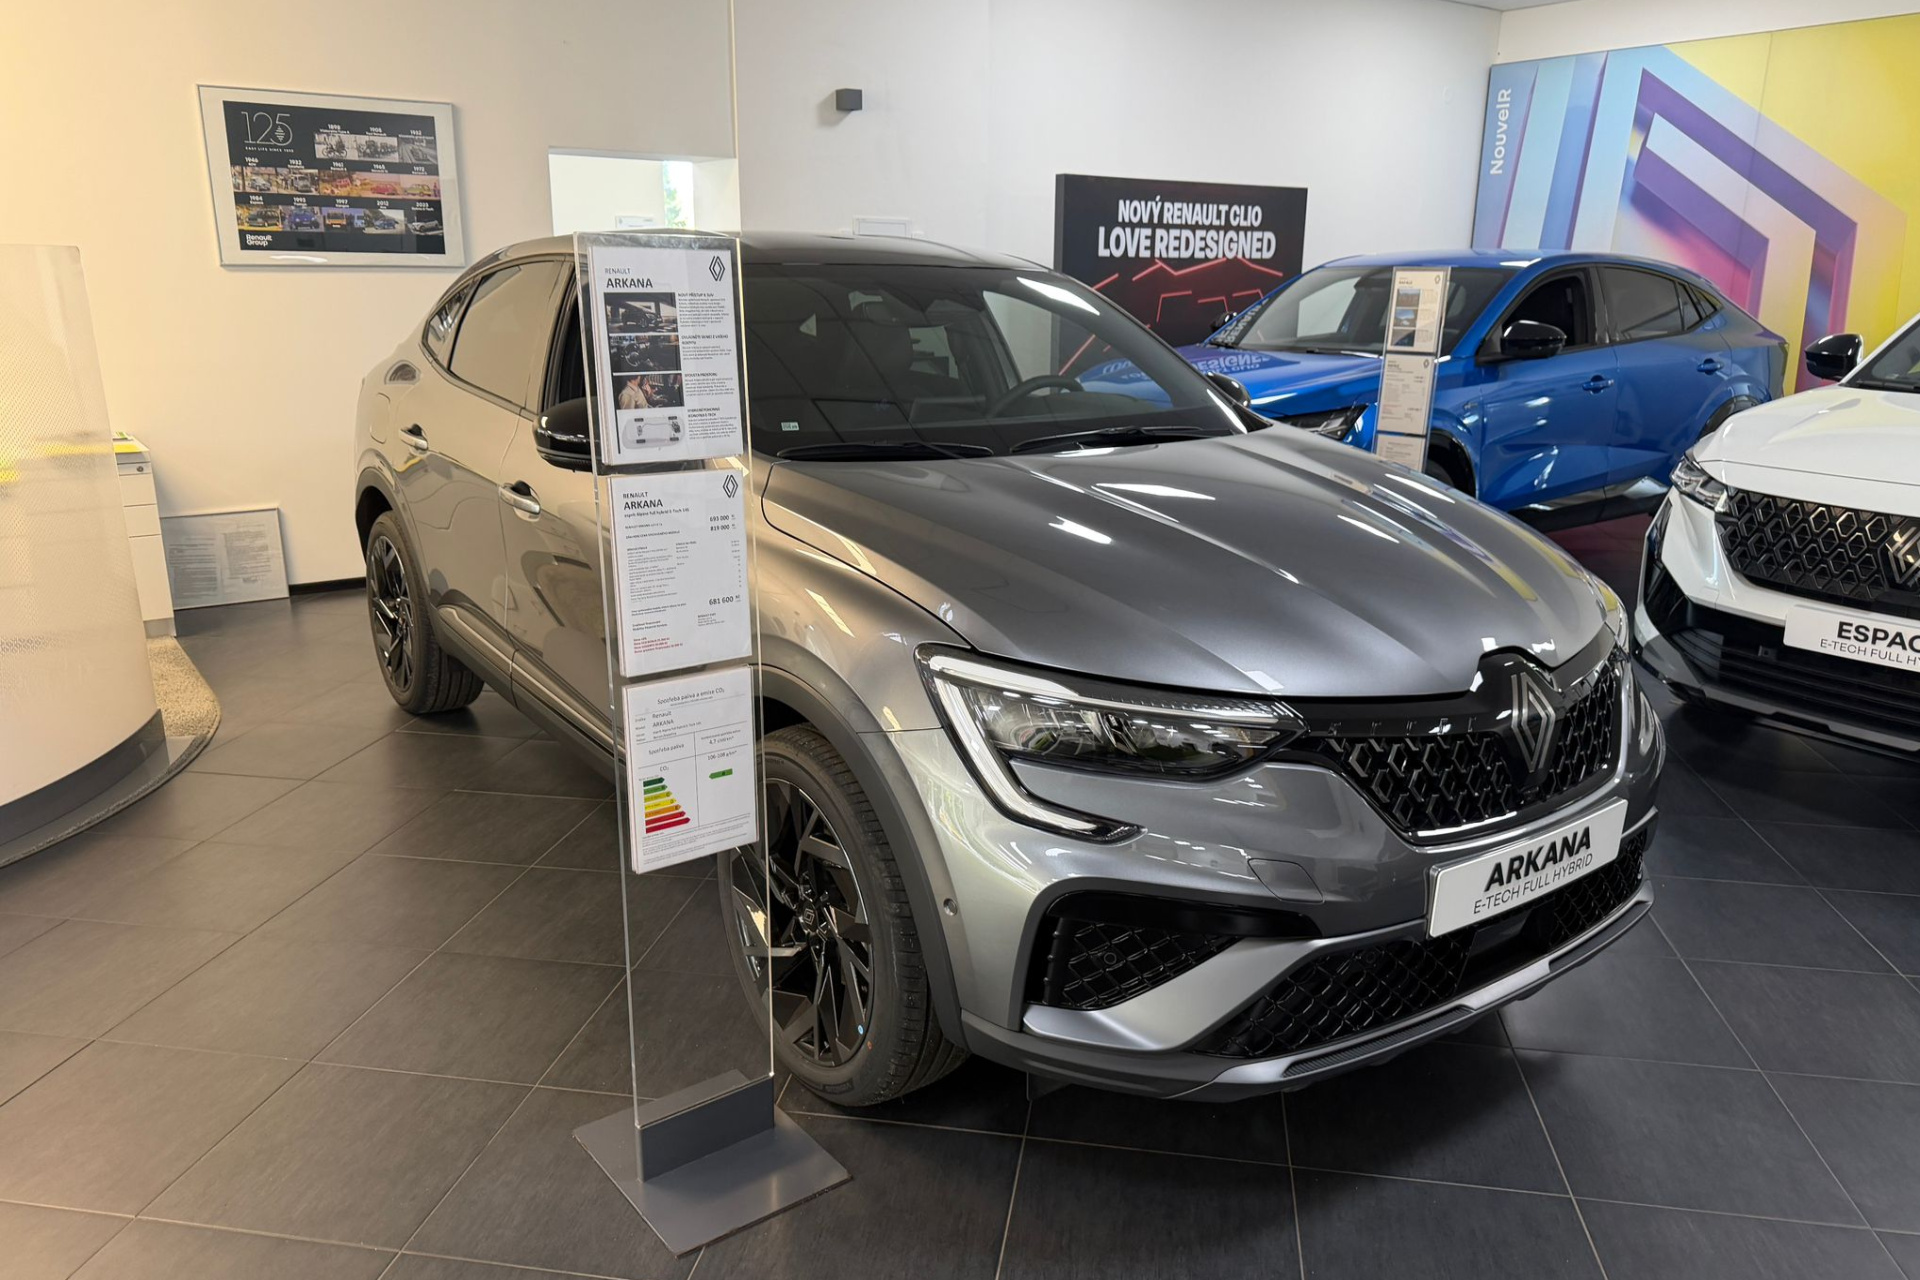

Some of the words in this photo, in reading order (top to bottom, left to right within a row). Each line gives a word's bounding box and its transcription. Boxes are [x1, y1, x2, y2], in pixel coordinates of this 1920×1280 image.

[241, 112, 293, 146] 125
[1118, 196, 1162, 224] NOVÝ
[1163, 202, 1230, 226] RENAULT
[1230, 204, 1262, 227] CLIO
[1098, 226, 1152, 258] LOVE
[1154, 228, 1276, 259] REDESIGNED
[605, 267, 631, 275] RENAULT
[606, 277, 653, 289] ARKANA
[622, 491, 648, 499] RENAULT
[624, 498, 663, 510] ARKANA
[1820, 638, 1867, 657] E-TECH
[1870, 648, 1903, 663] FULL
[657, 696, 680, 705] Spotřeba
[653, 719, 674, 727] ARKANA
[649, 747, 670, 755] Spotřeba
[1484, 826, 1591, 892] ARKANA
[1473, 885, 1520, 915] E-TECH
[1522, 874, 1550, 897] FULL
[1552, 853, 1593, 882] HYBRID
